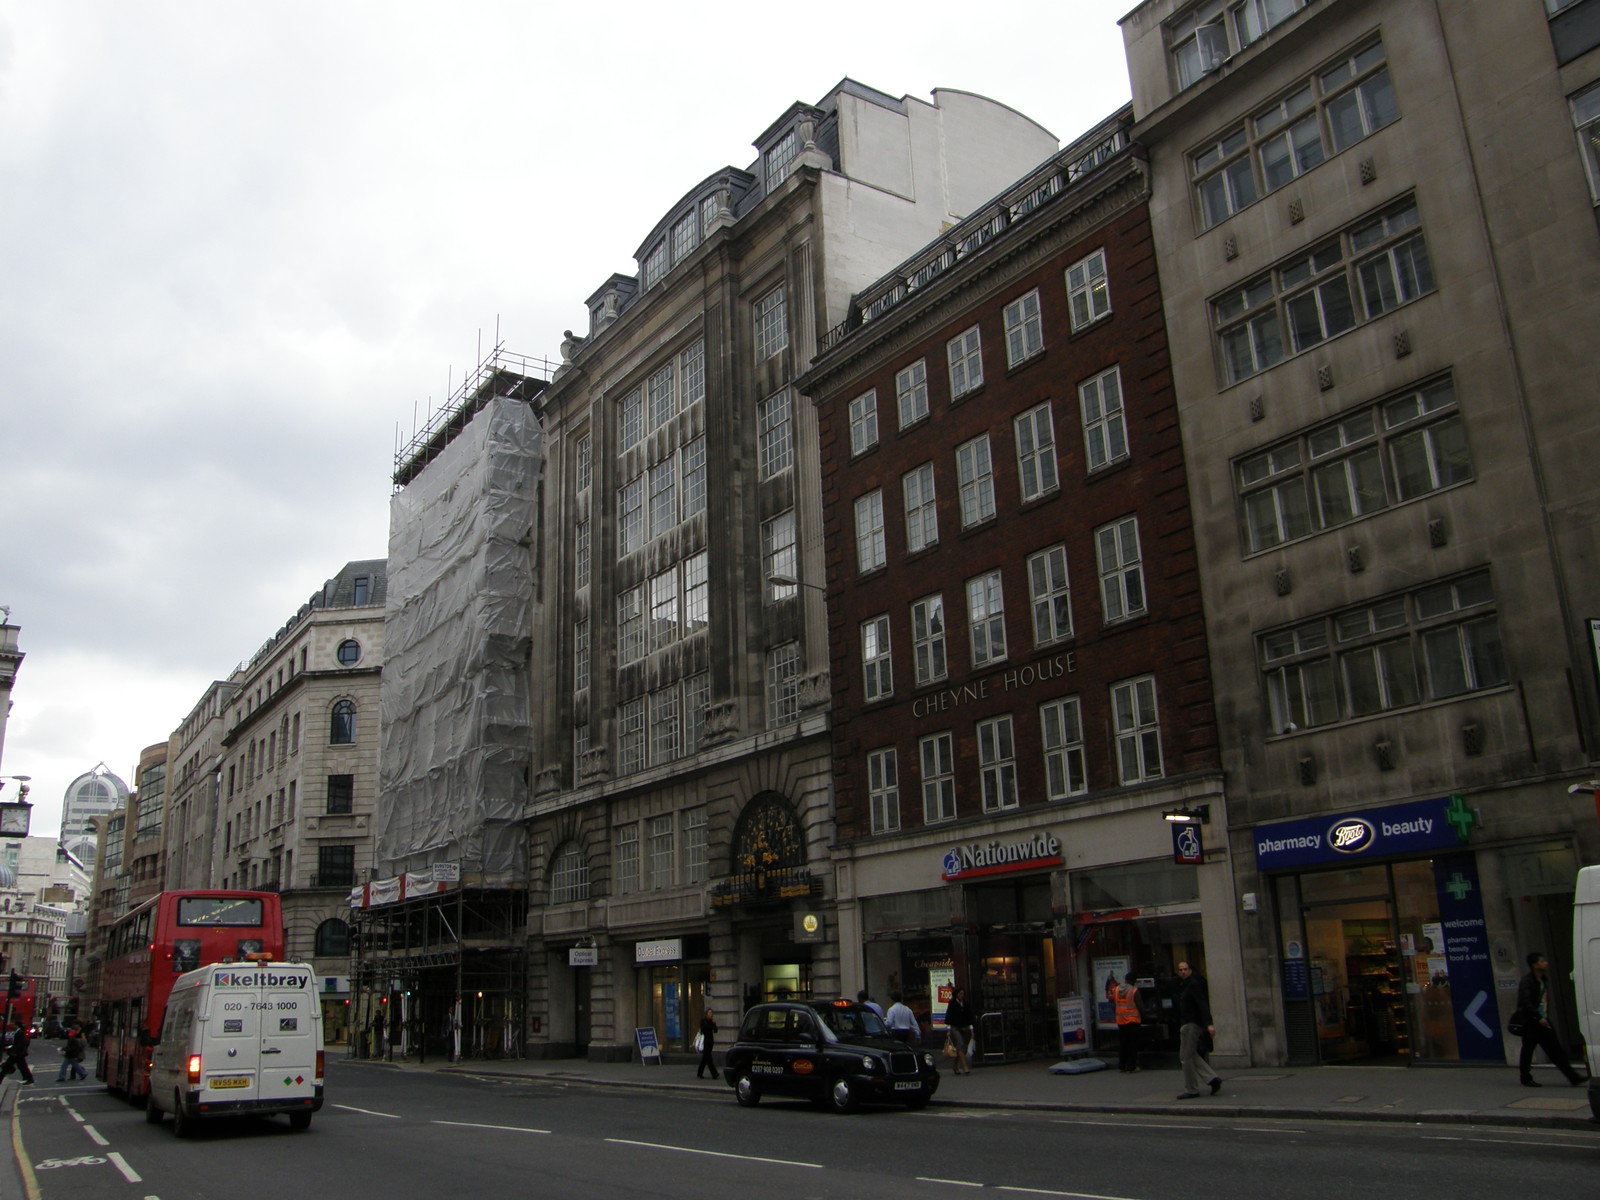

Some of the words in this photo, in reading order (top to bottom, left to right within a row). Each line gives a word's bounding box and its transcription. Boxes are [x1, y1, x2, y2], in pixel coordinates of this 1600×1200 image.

[912, 679, 990, 719] CHEYNE
[1004, 652, 1077, 692] HOUSE
[1382, 817, 1433, 837] beauty
[1334, 823, 1365, 848] Boots
[961, 831, 1061, 870] Nationwide
[1258, 834, 1321, 856] pharmacy
[1444, 918, 1485, 928] welcome
[1447, 937, 1478, 945] pharmacy
[574, 950, 593, 958] Optical
[655, 945, 677, 957] Express
[914, 957, 955, 969] Cheapside
[231, 972, 308, 989] keltbray
[224, 1002, 242, 1011] 020
[251, 1002, 273, 1011] 7643
[276, 1001, 298, 1010] 1000
